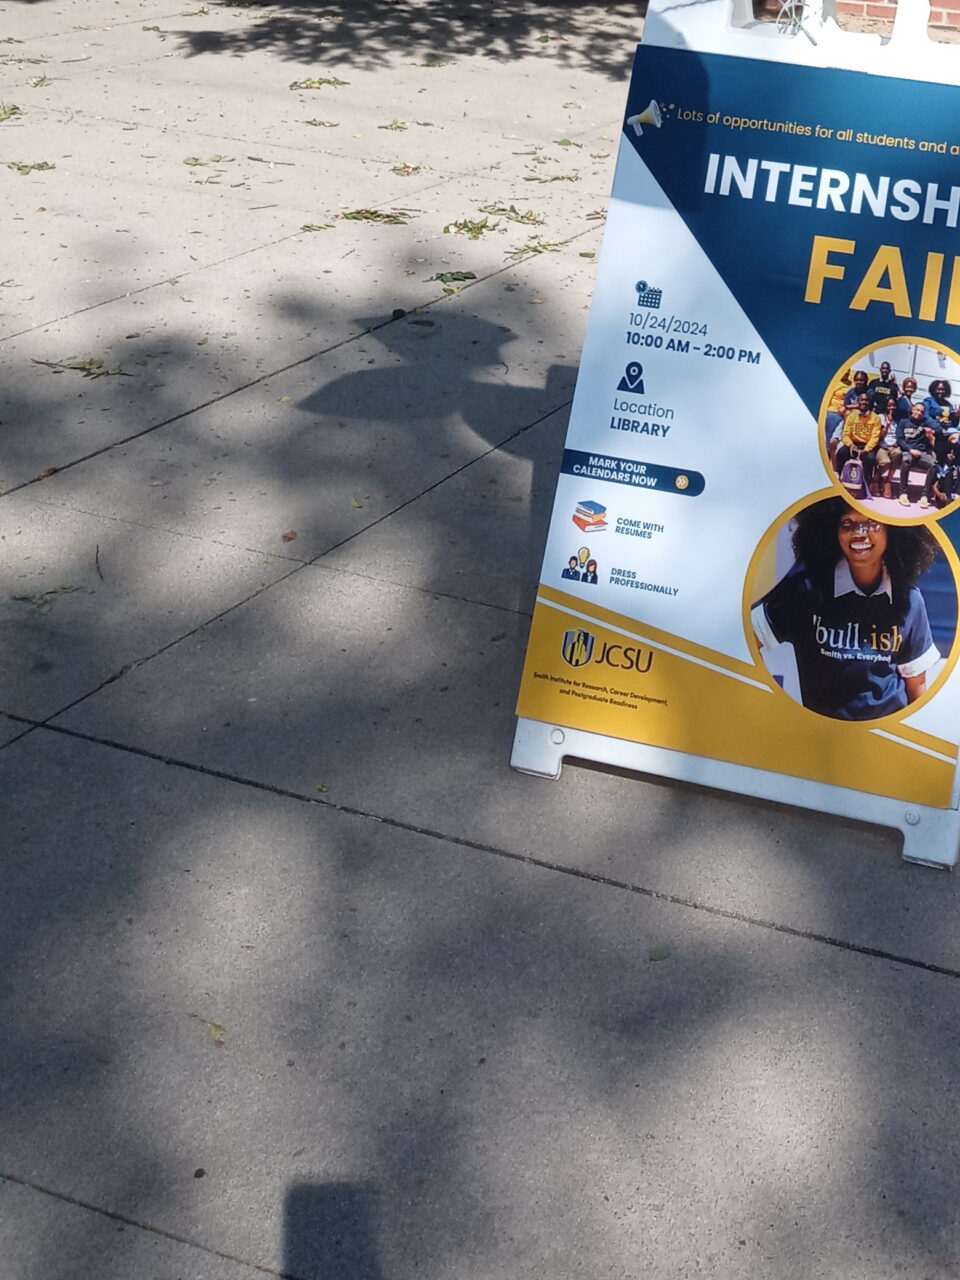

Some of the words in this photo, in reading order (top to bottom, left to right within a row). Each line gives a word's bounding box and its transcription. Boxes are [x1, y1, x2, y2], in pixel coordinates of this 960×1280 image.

[677, 108, 703, 121] Lots
[706, 112, 720, 124] of
[722, 115, 812, 136] opportunities
[815, 125, 834, 139] for
[836, 129, 853, 141] all
[856, 131, 916, 150] students
[918, 141, 947, 154] and
[629, 311, 708, 337] 10/24/2024
[626, 331, 663, 348] 10:00
[665, 338, 690, 353] AM
[703, 343, 735, 360] 2:00
[737, 349, 761, 364] PM
[613, 397, 675, 420] Location
[610, 416, 671, 438] LIBRARY
[573, 464, 630, 482] CALENDARS
[631, 474, 658, 487] NOW
[588, 456, 617, 470] MARK
[619, 461, 647, 475] YOUR
[615, 526, 653, 539] RESUMES
[616, 517, 642, 529] COME
[642, 521, 665, 533] WITH
[610, 567, 637, 579] DRESS
[609, 576, 679, 597] PROFESSIONALLY
[594, 642, 654, 673] JCSU
[820, 648, 842, 659] Smith
[534, 672, 549, 681] Smith
[550, 675, 572, 686] Institute
[582, 682, 608, 695] Research,
[609, 688, 629, 697] Career
[629, 692, 668, 707] Development,
[559, 688, 571, 696] and
[571, 690, 609, 704] Postgraduate
[609, 698, 638, 710] Readiness
